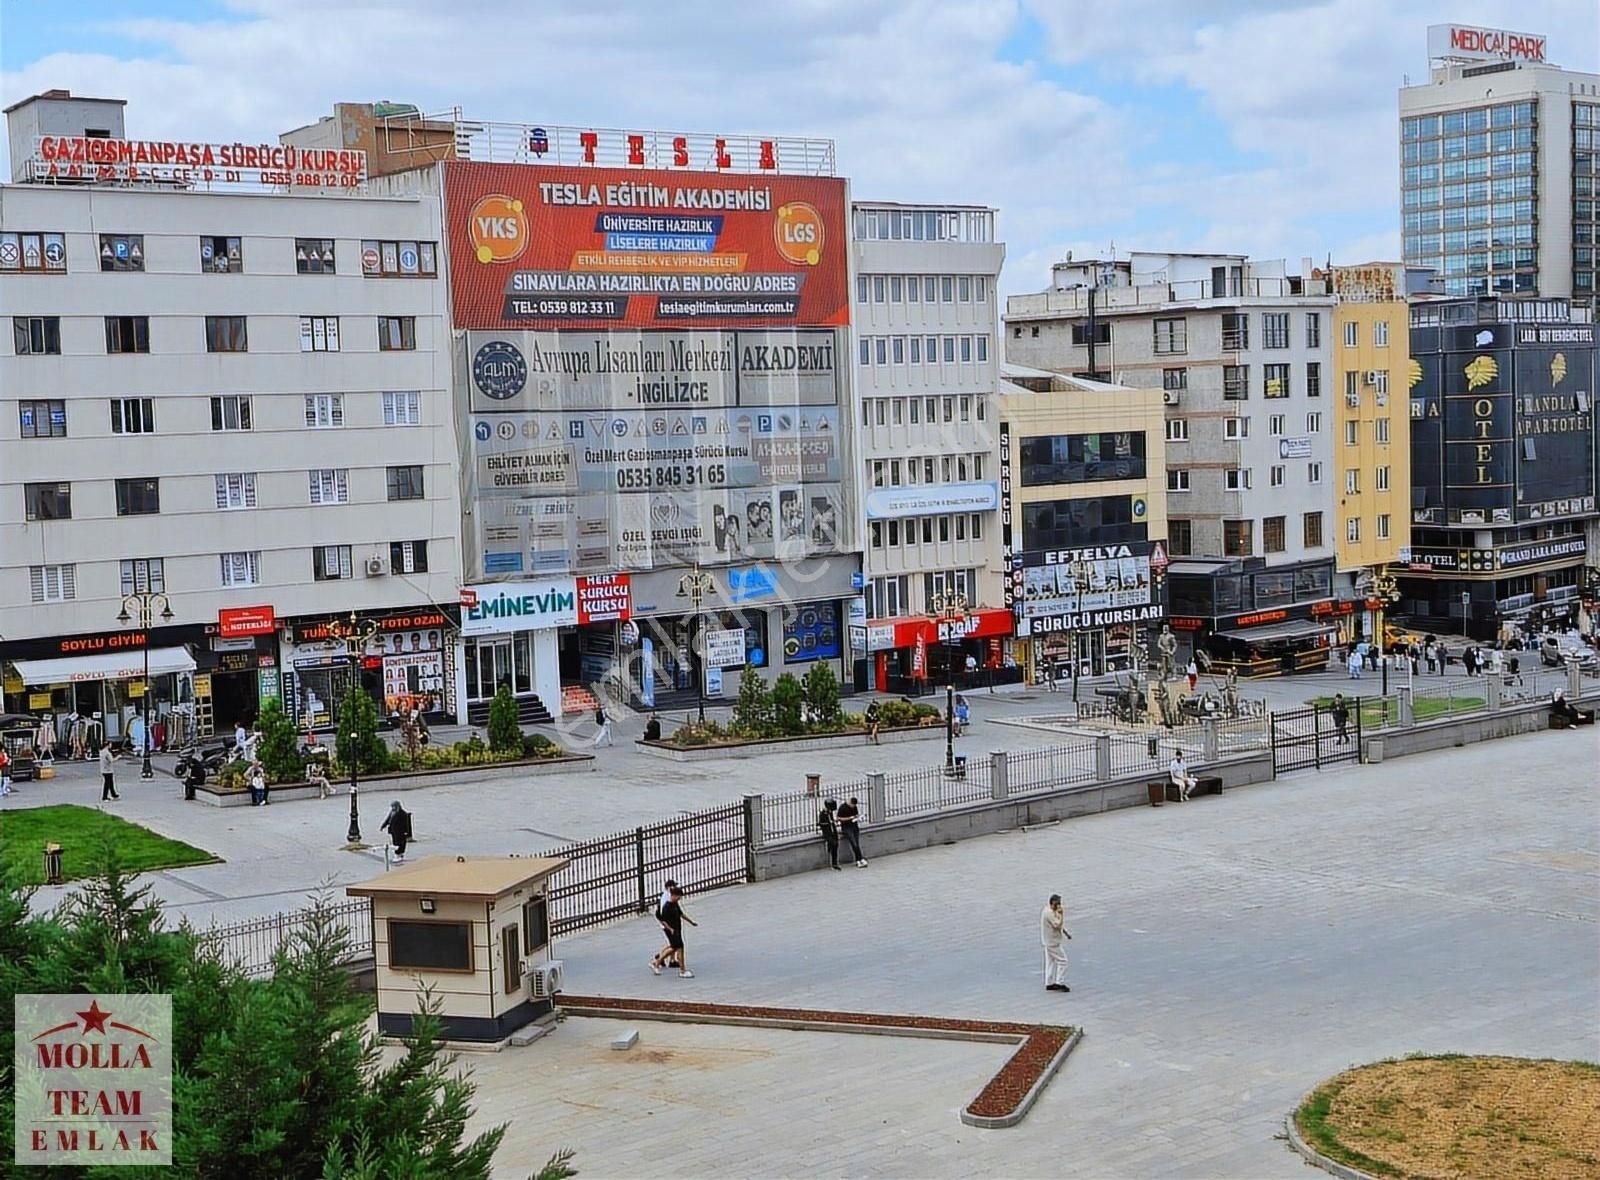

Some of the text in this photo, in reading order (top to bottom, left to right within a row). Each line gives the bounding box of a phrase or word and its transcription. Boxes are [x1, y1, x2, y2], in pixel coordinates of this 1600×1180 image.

[41, 136, 361, 172] GAZİOSMANPAŞA SÜRÜCÜ KURSU
[580, 132, 776, 170] TESLA
[260, 172, 292, 185] 0555
[296, 173, 320, 186] 988
[325, 174, 337, 187] 12
[341, 175, 358, 188] 00
[539, 181, 771, 211] TESLA EĞİTİM AKADEMİSİ
[477, 216, 518, 239] YKS
[603, 214, 713, 233] ÜNİVERSİTE HAZIRLIK
[784, 223, 816, 243] LGS
[610, 234, 708, 251] LİSELERE HAZIRLIK
[513, 273, 796, 292] SINAVLARA HAZIRLIKTA EN DOĞRU ADRES
[512, 301, 615, 314] TEL: 0539 812 33 11
[532, 339, 731, 381] Avrupa Lisanları Merkezi
[741, 339, 833, 371] AKADEMİ
[636, 376, 709, 403] İNGİLİZCE
[525, 454, 553, 467] ALMAK
[585, 447, 603, 463] Özel
[605, 449, 625, 462] Mert
[695, 445, 723, 459] Sürücü
[725, 446, 748, 458] Kursu
[540, 470, 565, 483] ADRES
[617, 464, 725, 488] 0535 845 31 65
[622, 529, 647, 541] ÖZEL
[651, 526, 678, 541] SEVGİ
[1045, 545, 1132, 564] EFTELYA
[468, 587, 574, 621] EMİNEVİM
[583, 597, 628, 612] KURSU
[381, 618, 410, 629] FOTO
[1033, 612, 1091, 633] SÜRÜCÜ
[1094, 604, 1163, 627] KURSLARI
[60, 632, 146, 652] SOYLU GİYİM
